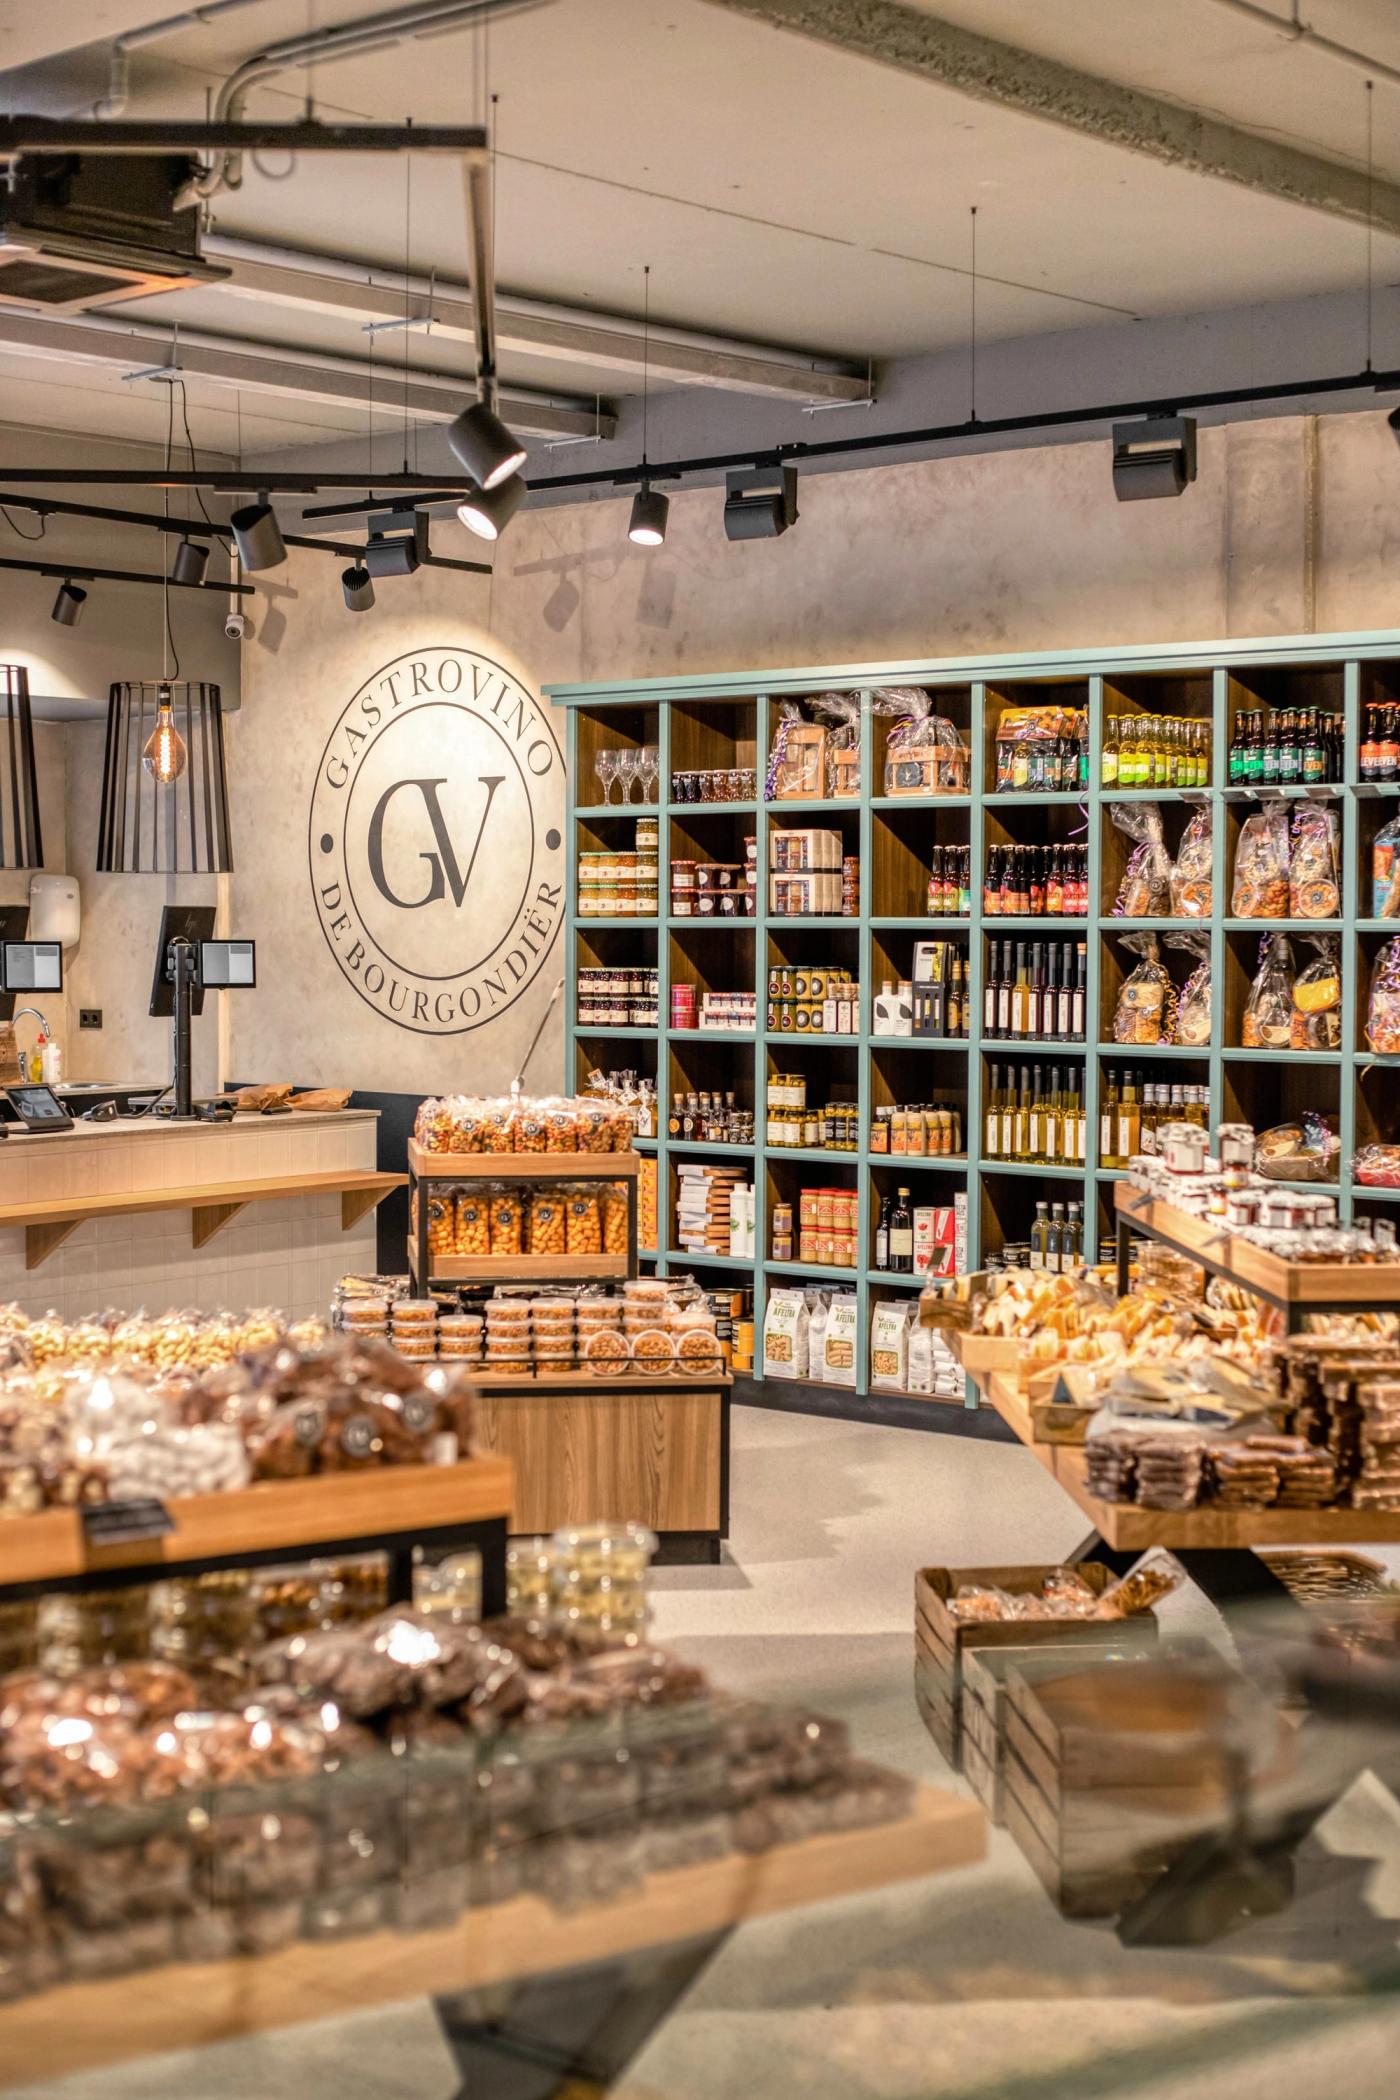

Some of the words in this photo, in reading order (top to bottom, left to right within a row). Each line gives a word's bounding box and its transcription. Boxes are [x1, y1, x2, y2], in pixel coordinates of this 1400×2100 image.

[326, 659, 553, 789] GASTROVINO
[368, 776, 506, 909] GV
[321, 880, 352, 941] DE
[346, 881, 562, 1023] BOURGONDIËR
[773, 1307, 796, 1318] AFELTRA
[835, 1314, 856, 1324] AFELTRA
